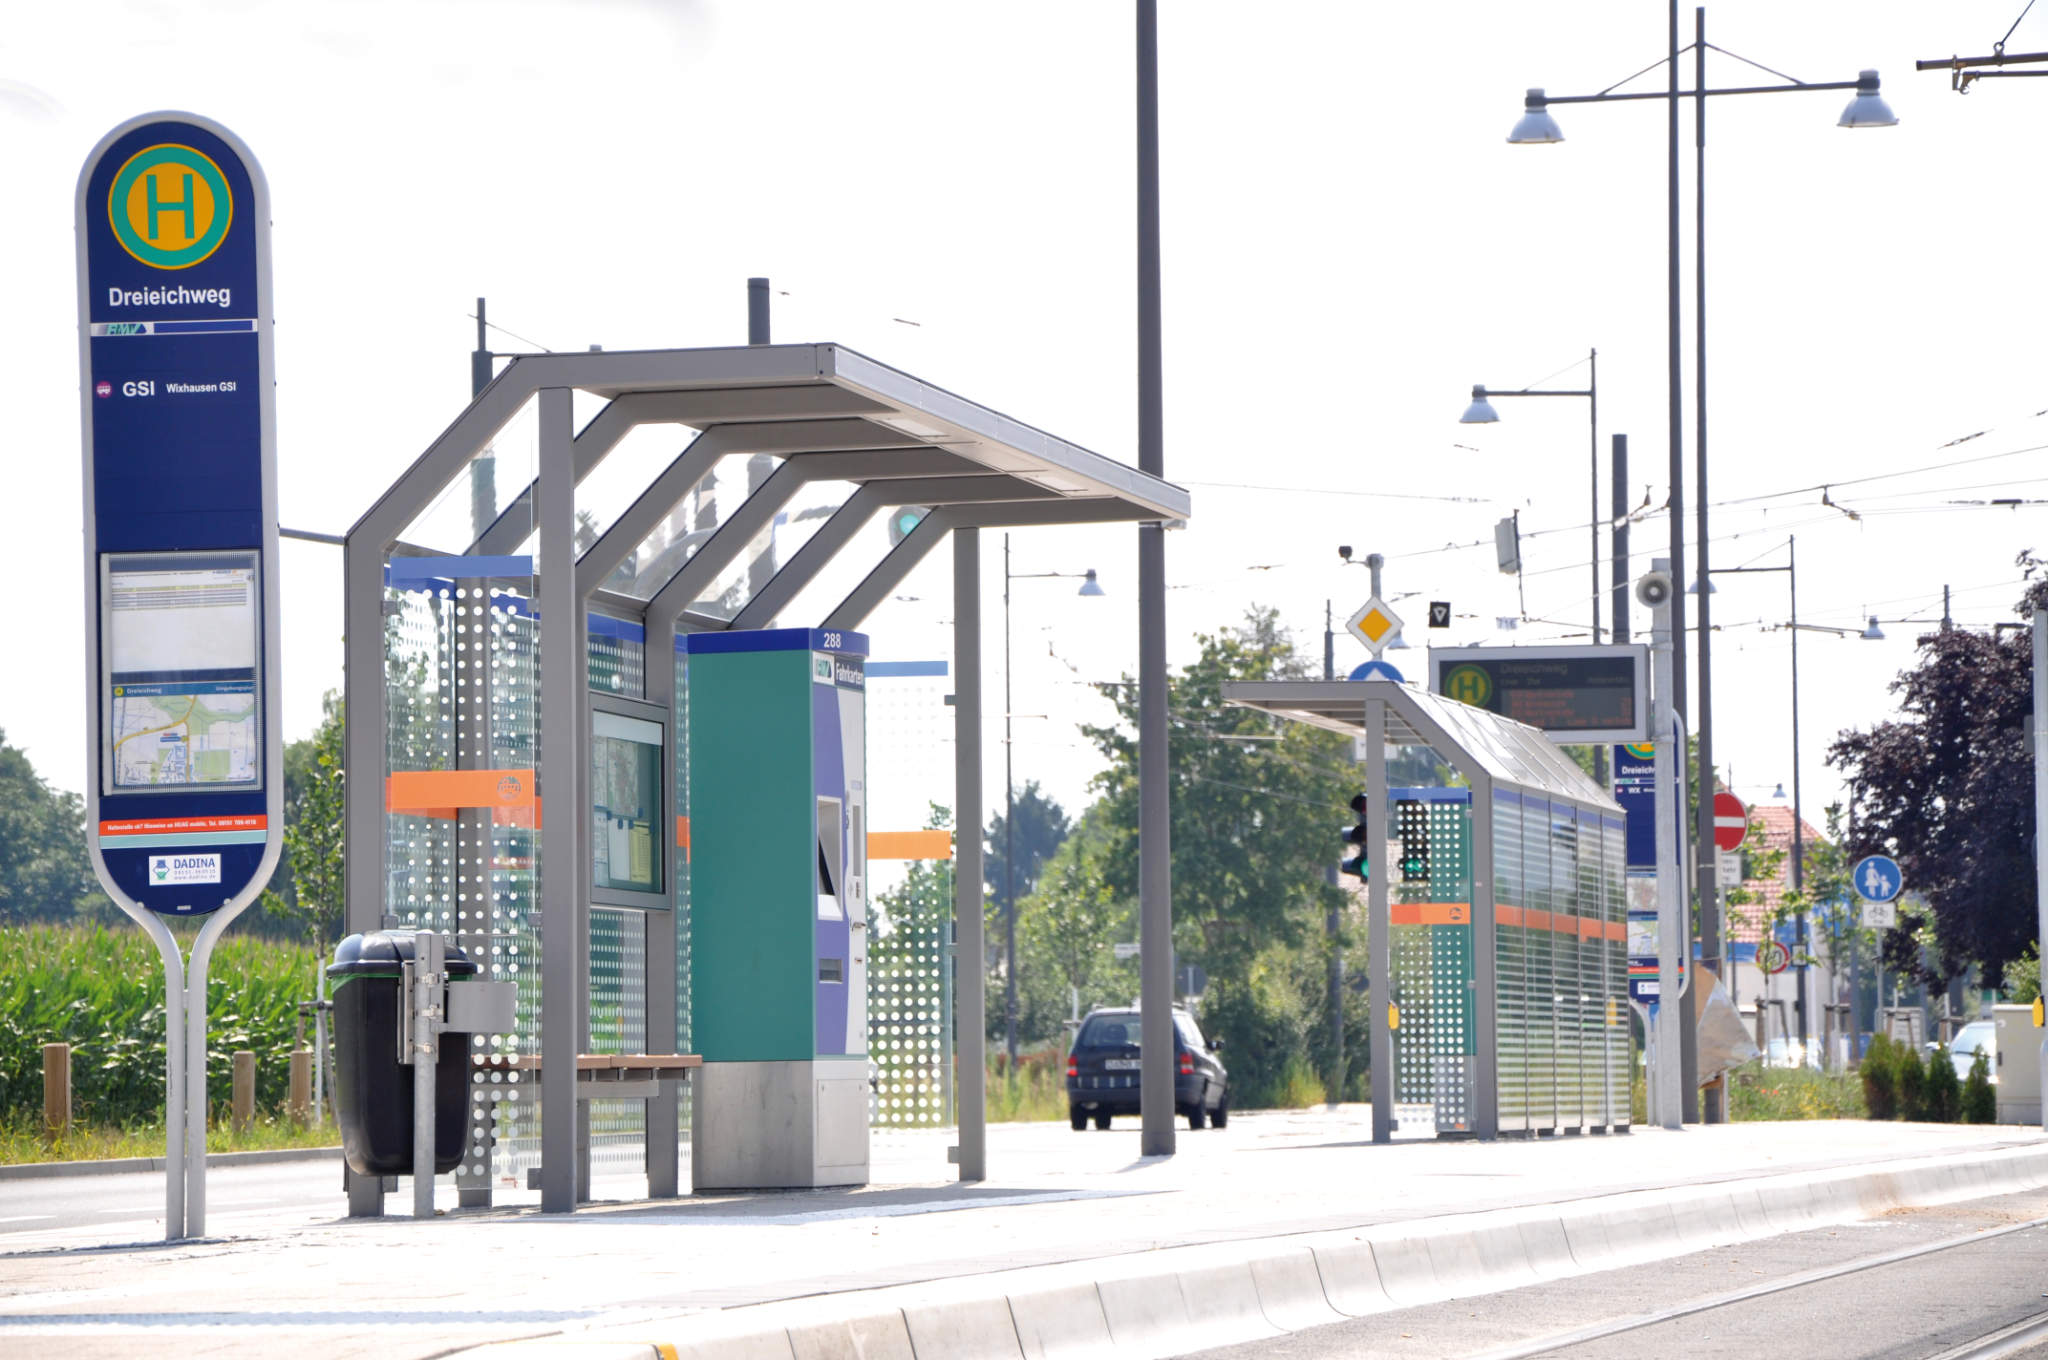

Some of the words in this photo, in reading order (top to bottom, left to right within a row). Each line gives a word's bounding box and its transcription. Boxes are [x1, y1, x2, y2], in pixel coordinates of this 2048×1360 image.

[146, 173, 195, 240] H
[109, 285, 231, 308] Dreieichweg
[122, 381, 155, 397] GSI
[166, 383, 218, 394] Wixhausen
[219, 382, 237, 392] GSI
[824, 633, 841, 648] 288
[835, 662, 864, 684] Fahrkarten
[1458, 676, 1478, 700] H
[1621, 766, 1656, 775] Dreieich
[174, 858, 215, 869] DADINA
